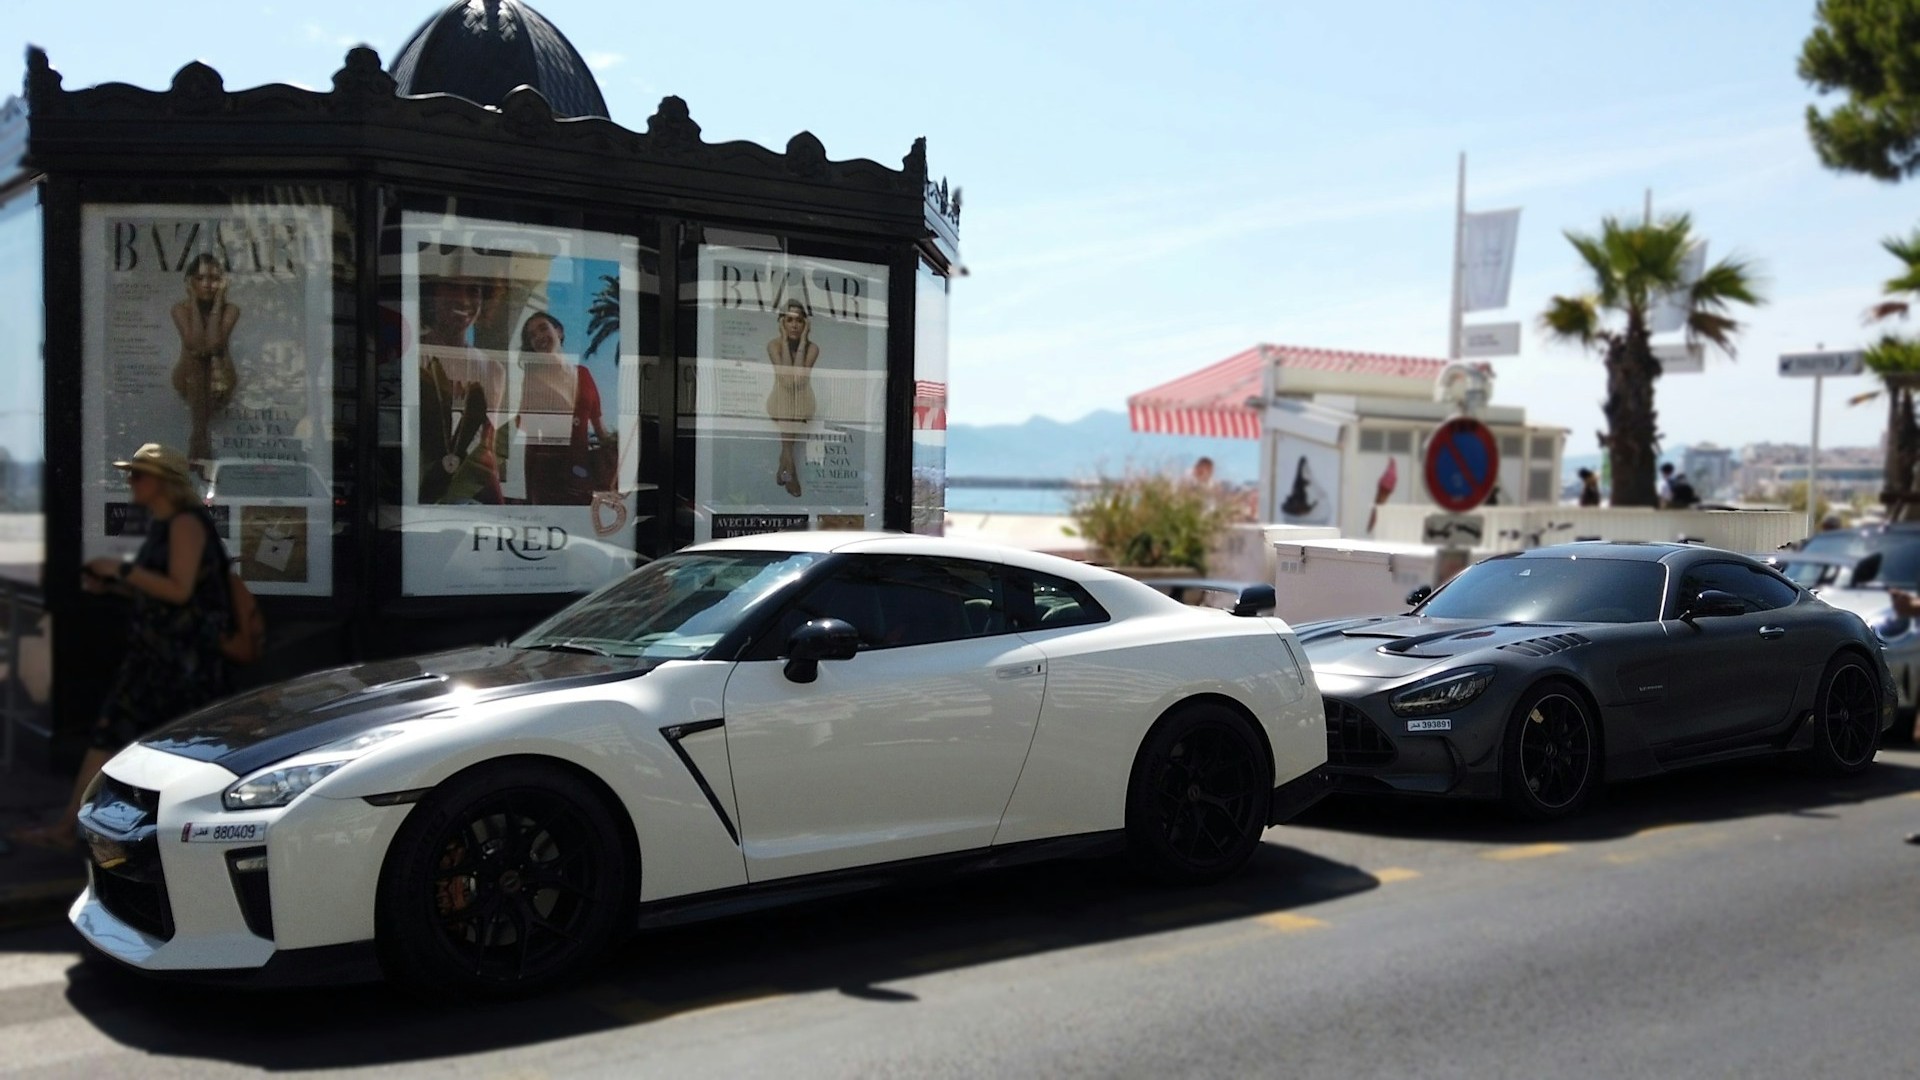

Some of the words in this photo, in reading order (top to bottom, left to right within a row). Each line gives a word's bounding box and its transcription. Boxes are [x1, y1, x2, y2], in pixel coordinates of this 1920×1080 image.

[721, 264, 862, 321] BAZAAR
[717, 517, 742, 528] AVEC
[743, 517, 755, 528] LE
[759, 517, 784, 528] TOTE
[471, 525, 568, 562] FRED
[1422, 720, 1451, 729] 393891
[213, 824, 256, 840] 880409
